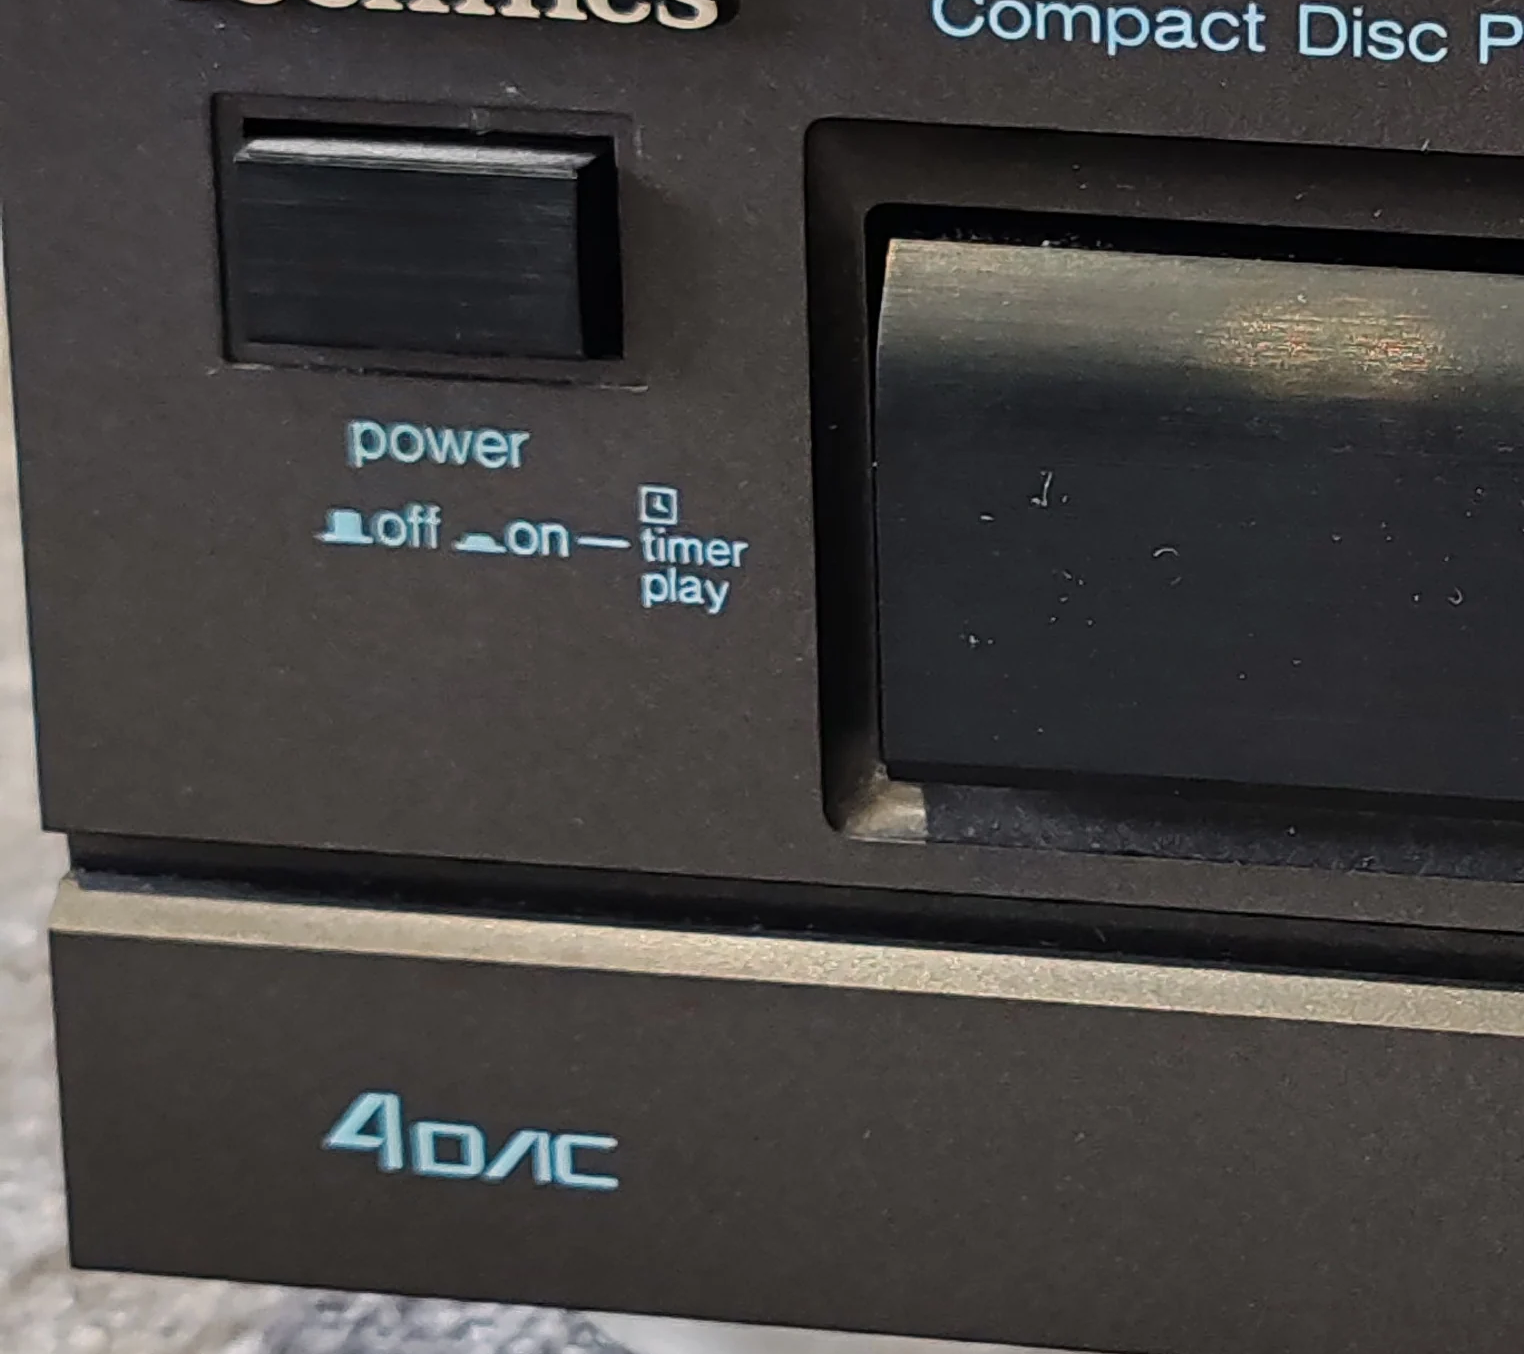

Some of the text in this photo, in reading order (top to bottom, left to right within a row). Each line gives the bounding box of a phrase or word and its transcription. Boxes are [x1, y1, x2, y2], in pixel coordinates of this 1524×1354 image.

[1299, 3, 1449, 63] Disc
[348, 420, 530, 469] power
[374, 503, 569, 557] off on
[641, 527, 749, 567] timer
[641, 567, 730, 614] play
